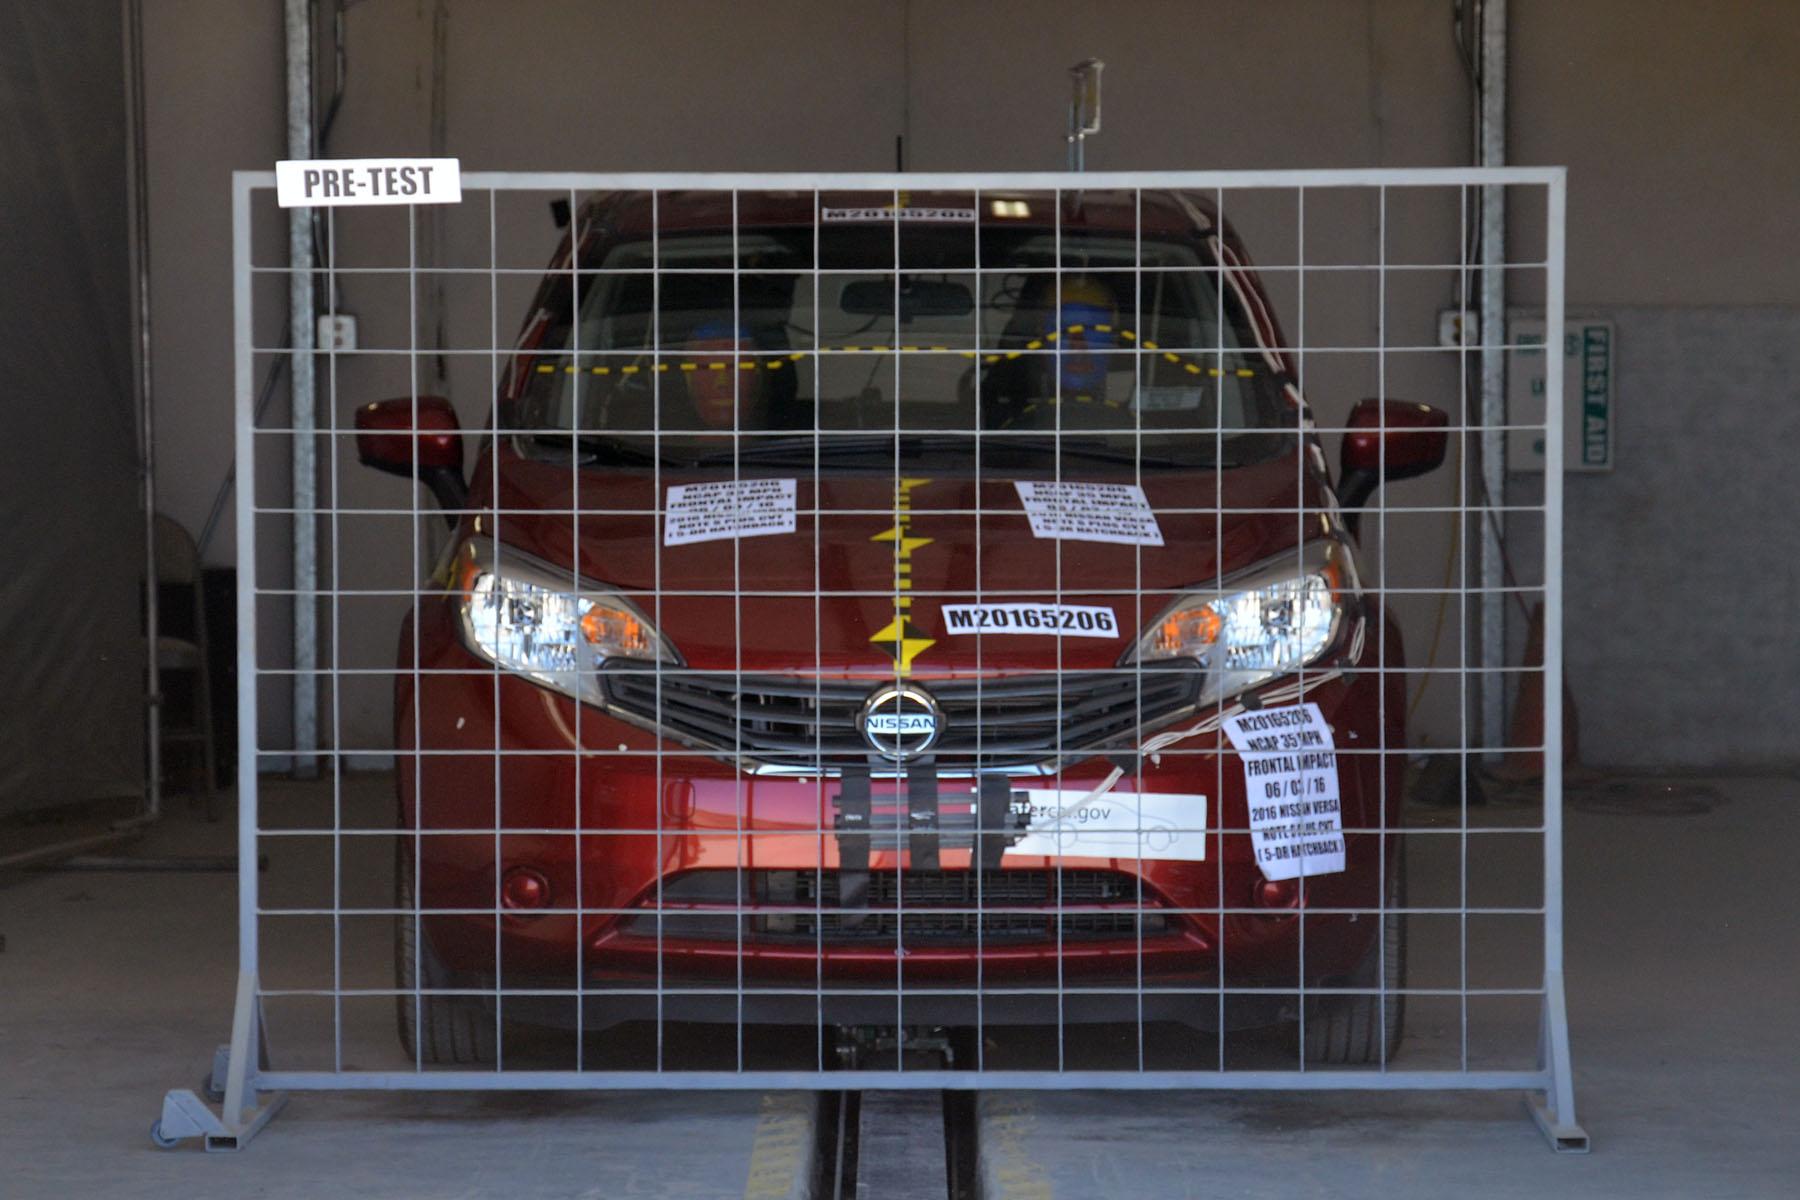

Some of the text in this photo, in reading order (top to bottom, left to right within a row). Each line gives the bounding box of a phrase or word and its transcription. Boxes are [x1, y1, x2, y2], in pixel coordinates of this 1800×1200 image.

[303, 165, 434, 198] PRE-TEST
[1587, 329, 1607, 462] FIRST AID
[947, 609, 1114, 632] M20165206
[866, 718, 936, 729] NISSAN
[1236, 709, 1313, 733] M20165206
[1246, 738, 1280, 751] NCAP
[1283, 734, 1298, 748] 35
[1248, 753, 1335, 777] FRONTAL IMPACT
[1265, 783, 1279, 799] 06
[1314, 777, 1325, 792] 16
[1252, 808, 1277, 822] 2016
[1313, 799, 1339, 813] VERSA
[1265, 845, 1291, 860] 5-DR
